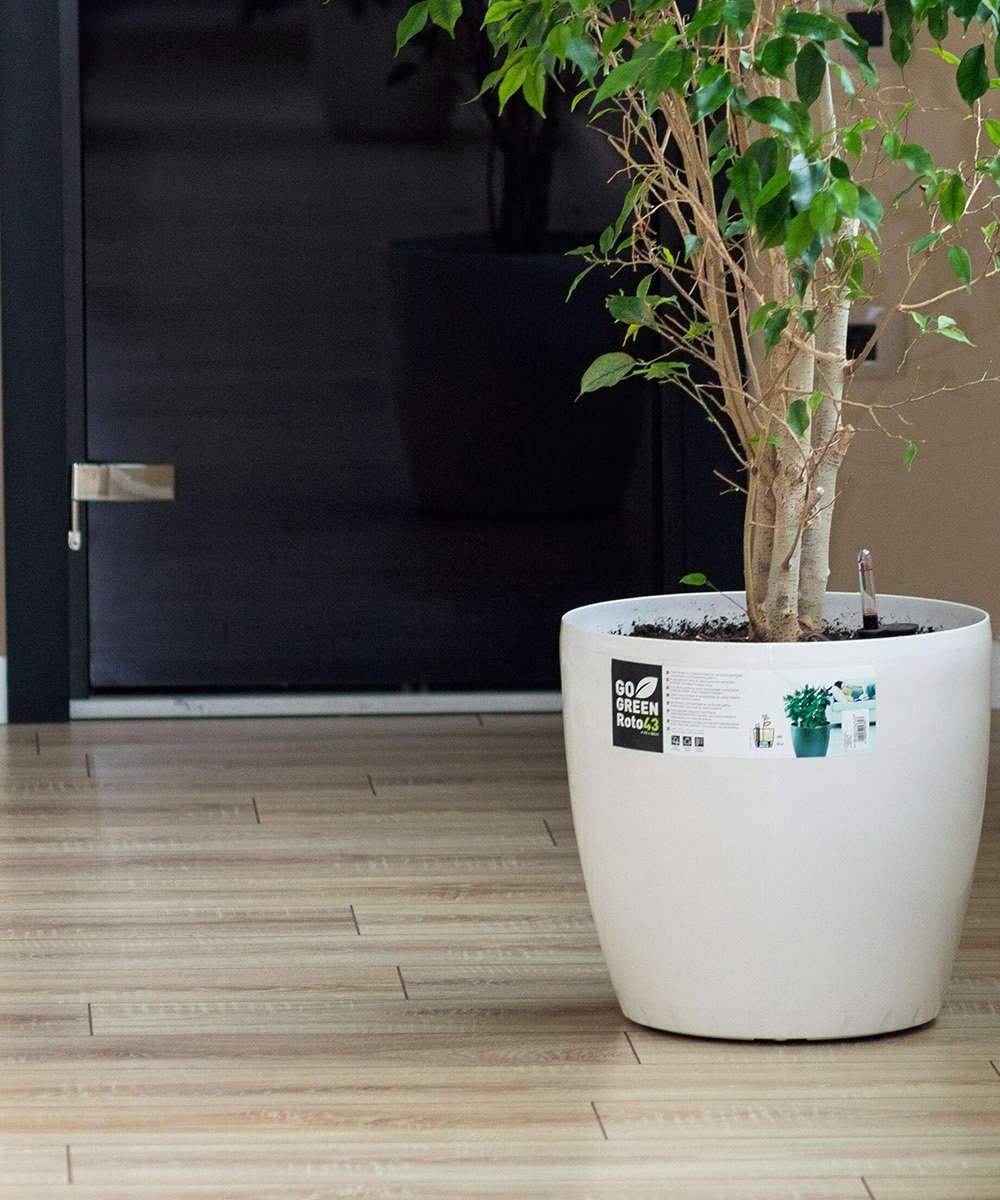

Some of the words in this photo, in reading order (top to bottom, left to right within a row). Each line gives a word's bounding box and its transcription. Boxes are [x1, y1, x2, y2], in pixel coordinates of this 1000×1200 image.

[615, 679, 635, 698] GO
[616, 697, 659, 716] GREEN
[616, 712, 659, 732] Roto43
